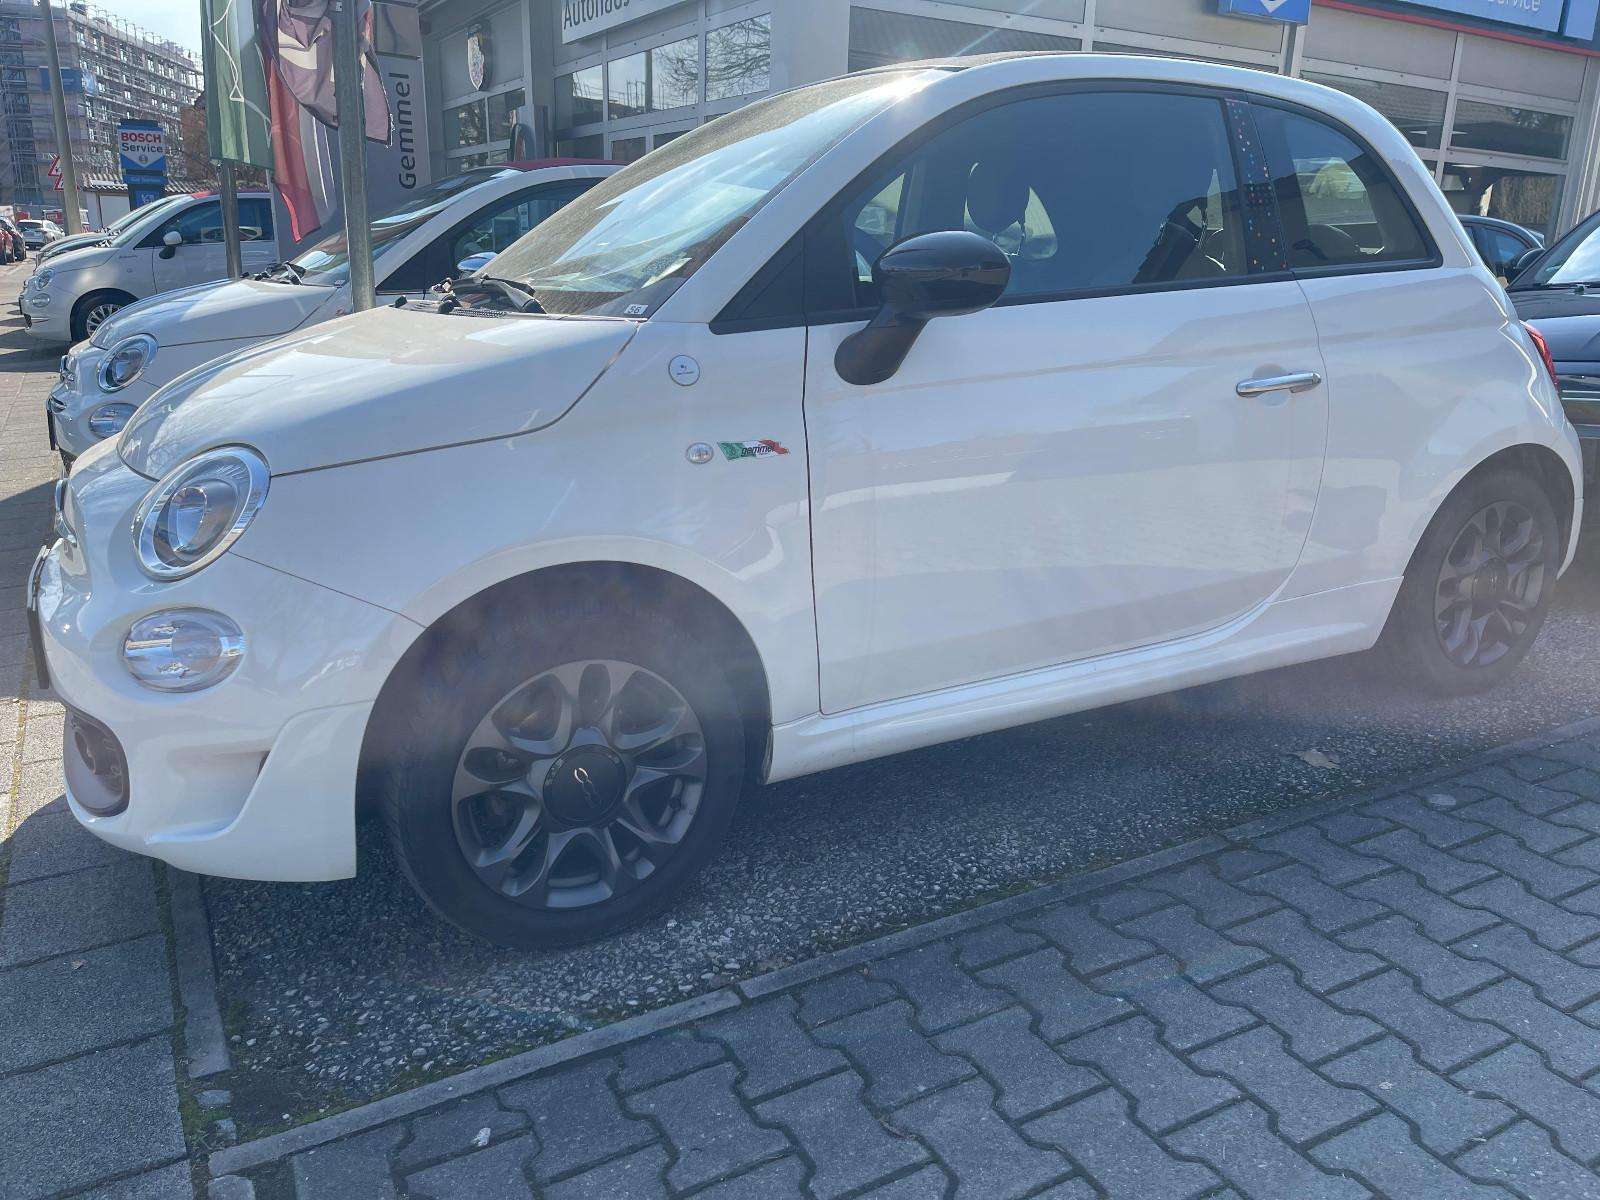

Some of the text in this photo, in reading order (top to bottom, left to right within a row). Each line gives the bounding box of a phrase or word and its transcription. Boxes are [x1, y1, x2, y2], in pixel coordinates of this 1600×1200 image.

[1488, 0, 1540, 11] rvice
[389, 72, 416, 190] Gemmel
[121, 132, 161, 143] BOSCH
[121, 143, 163, 153] Service
